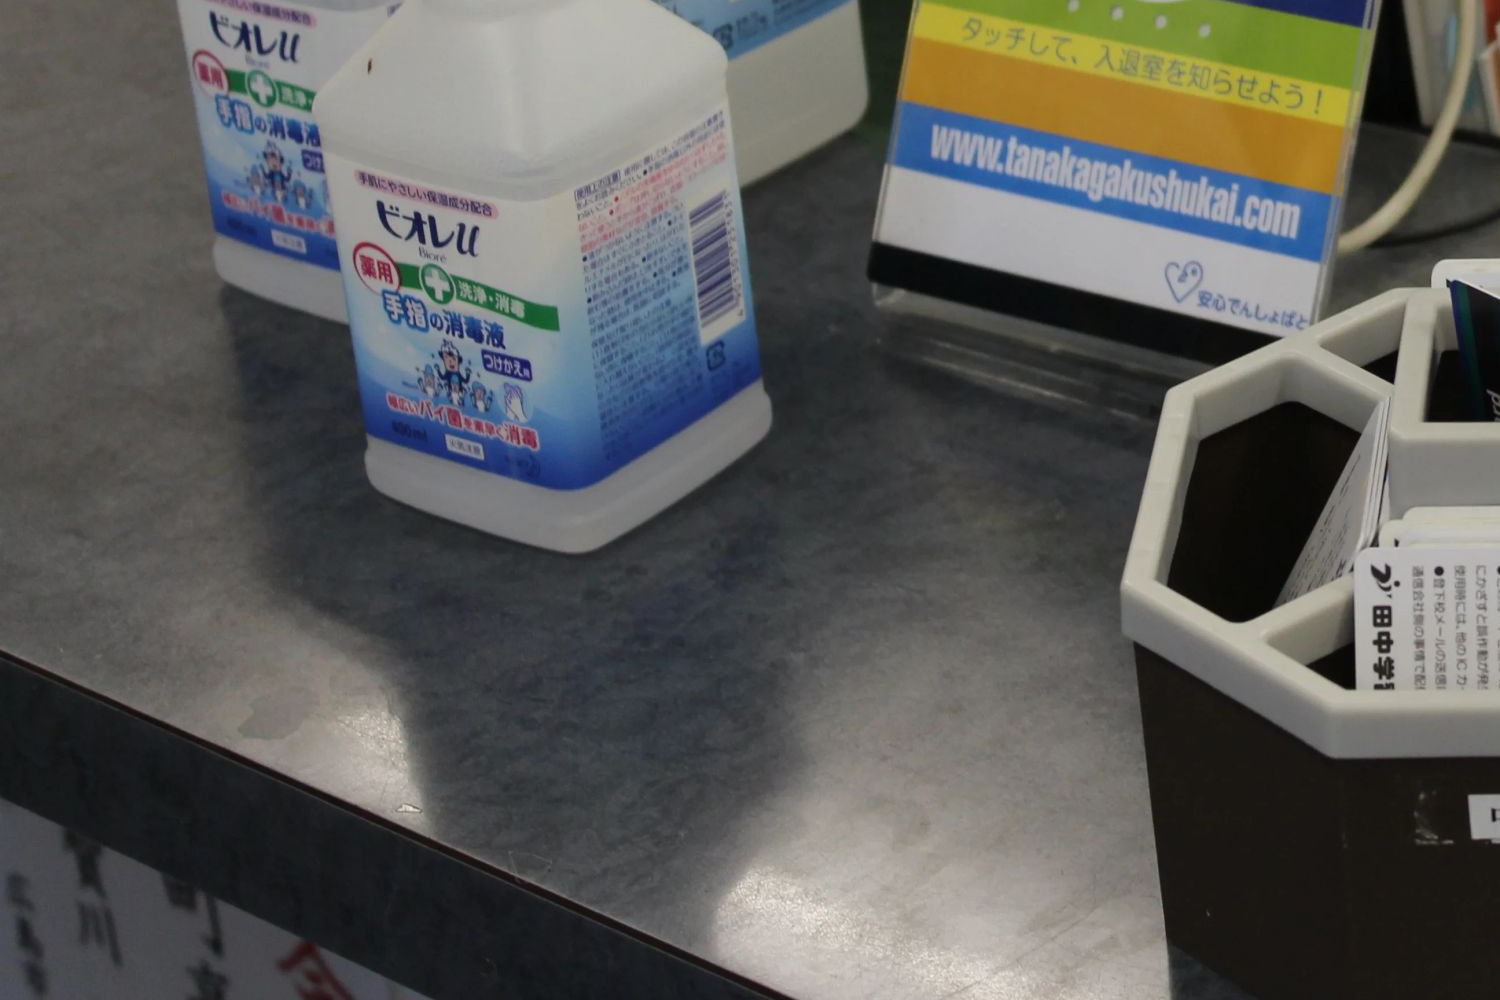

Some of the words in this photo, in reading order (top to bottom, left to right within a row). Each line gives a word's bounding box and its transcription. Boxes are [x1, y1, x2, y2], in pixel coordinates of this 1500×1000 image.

[358, 171, 493, 217] 手肌にやさしい保湿成分配合
[929, 122, 1301, 240] www.tanakagakushukai.com
[376, 200, 481, 258] ビオレu
[359, 254, 395, 285] 薬用
[382, 290, 507, 350] 手指の消毒液
